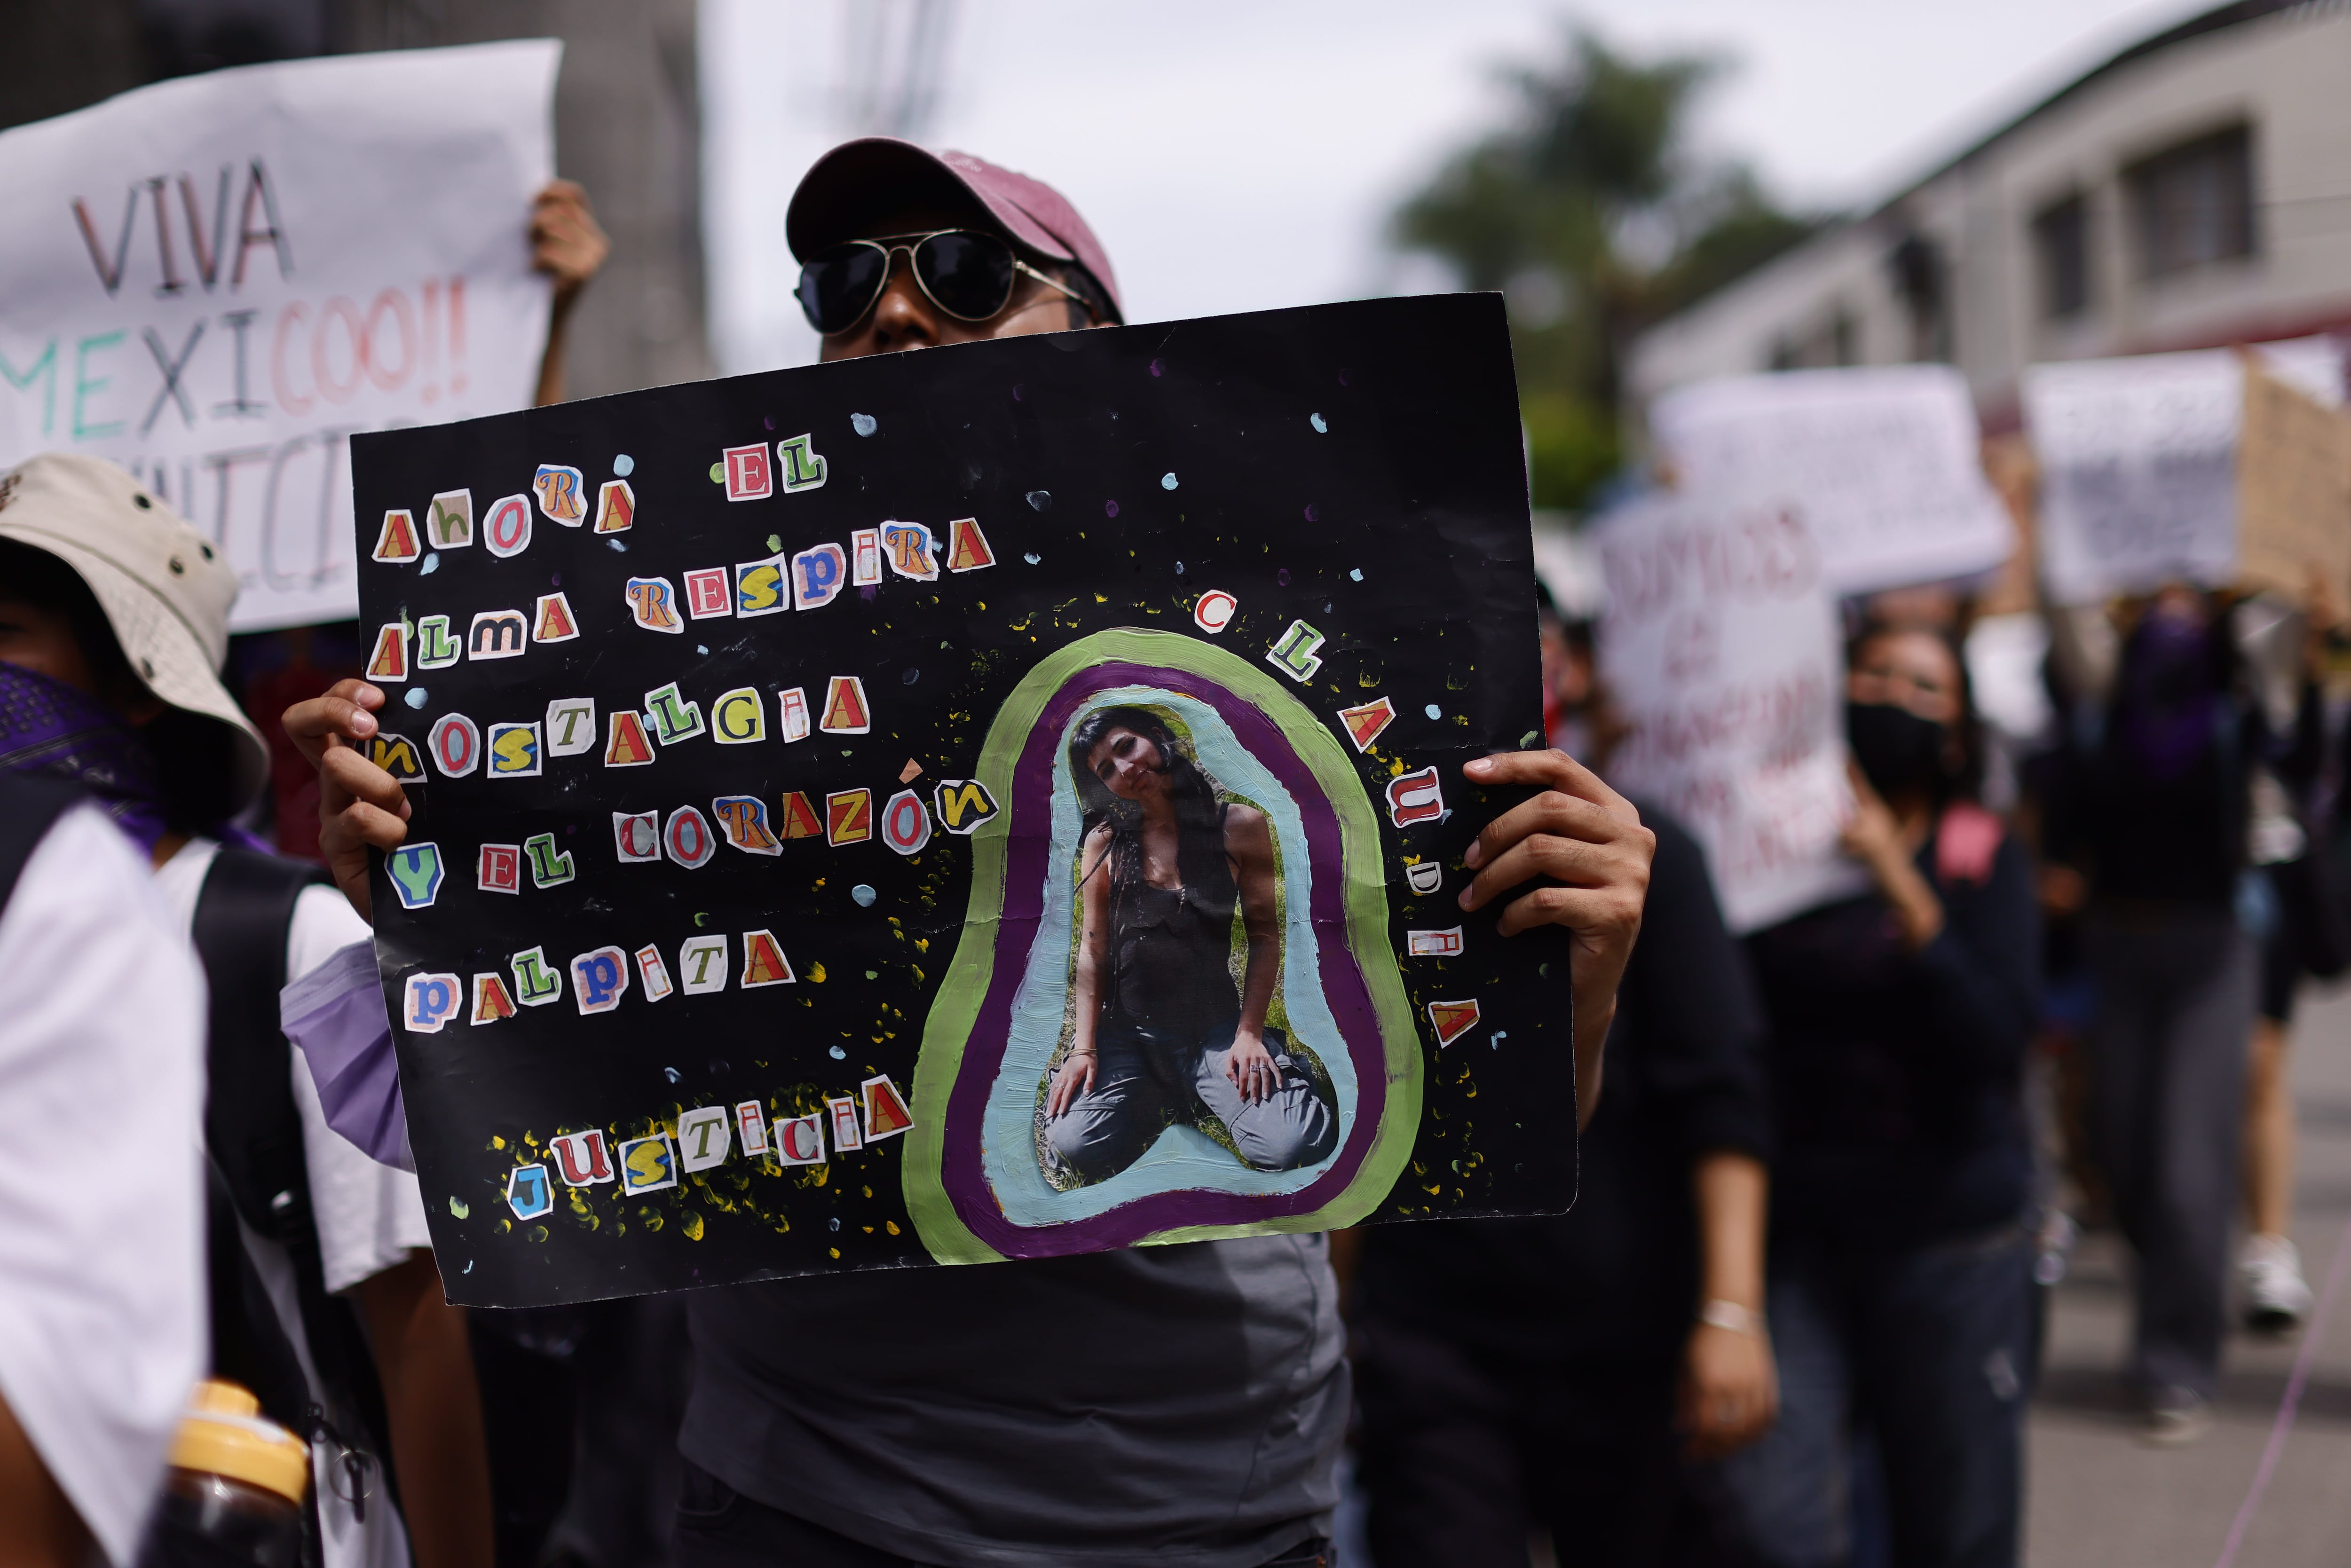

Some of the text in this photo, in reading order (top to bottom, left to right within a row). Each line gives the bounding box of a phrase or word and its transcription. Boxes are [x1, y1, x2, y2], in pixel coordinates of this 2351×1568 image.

[71, 154, 295, 298] VIVA
[731, 442, 823, 496] EL
[484, 840, 574, 888] EL
